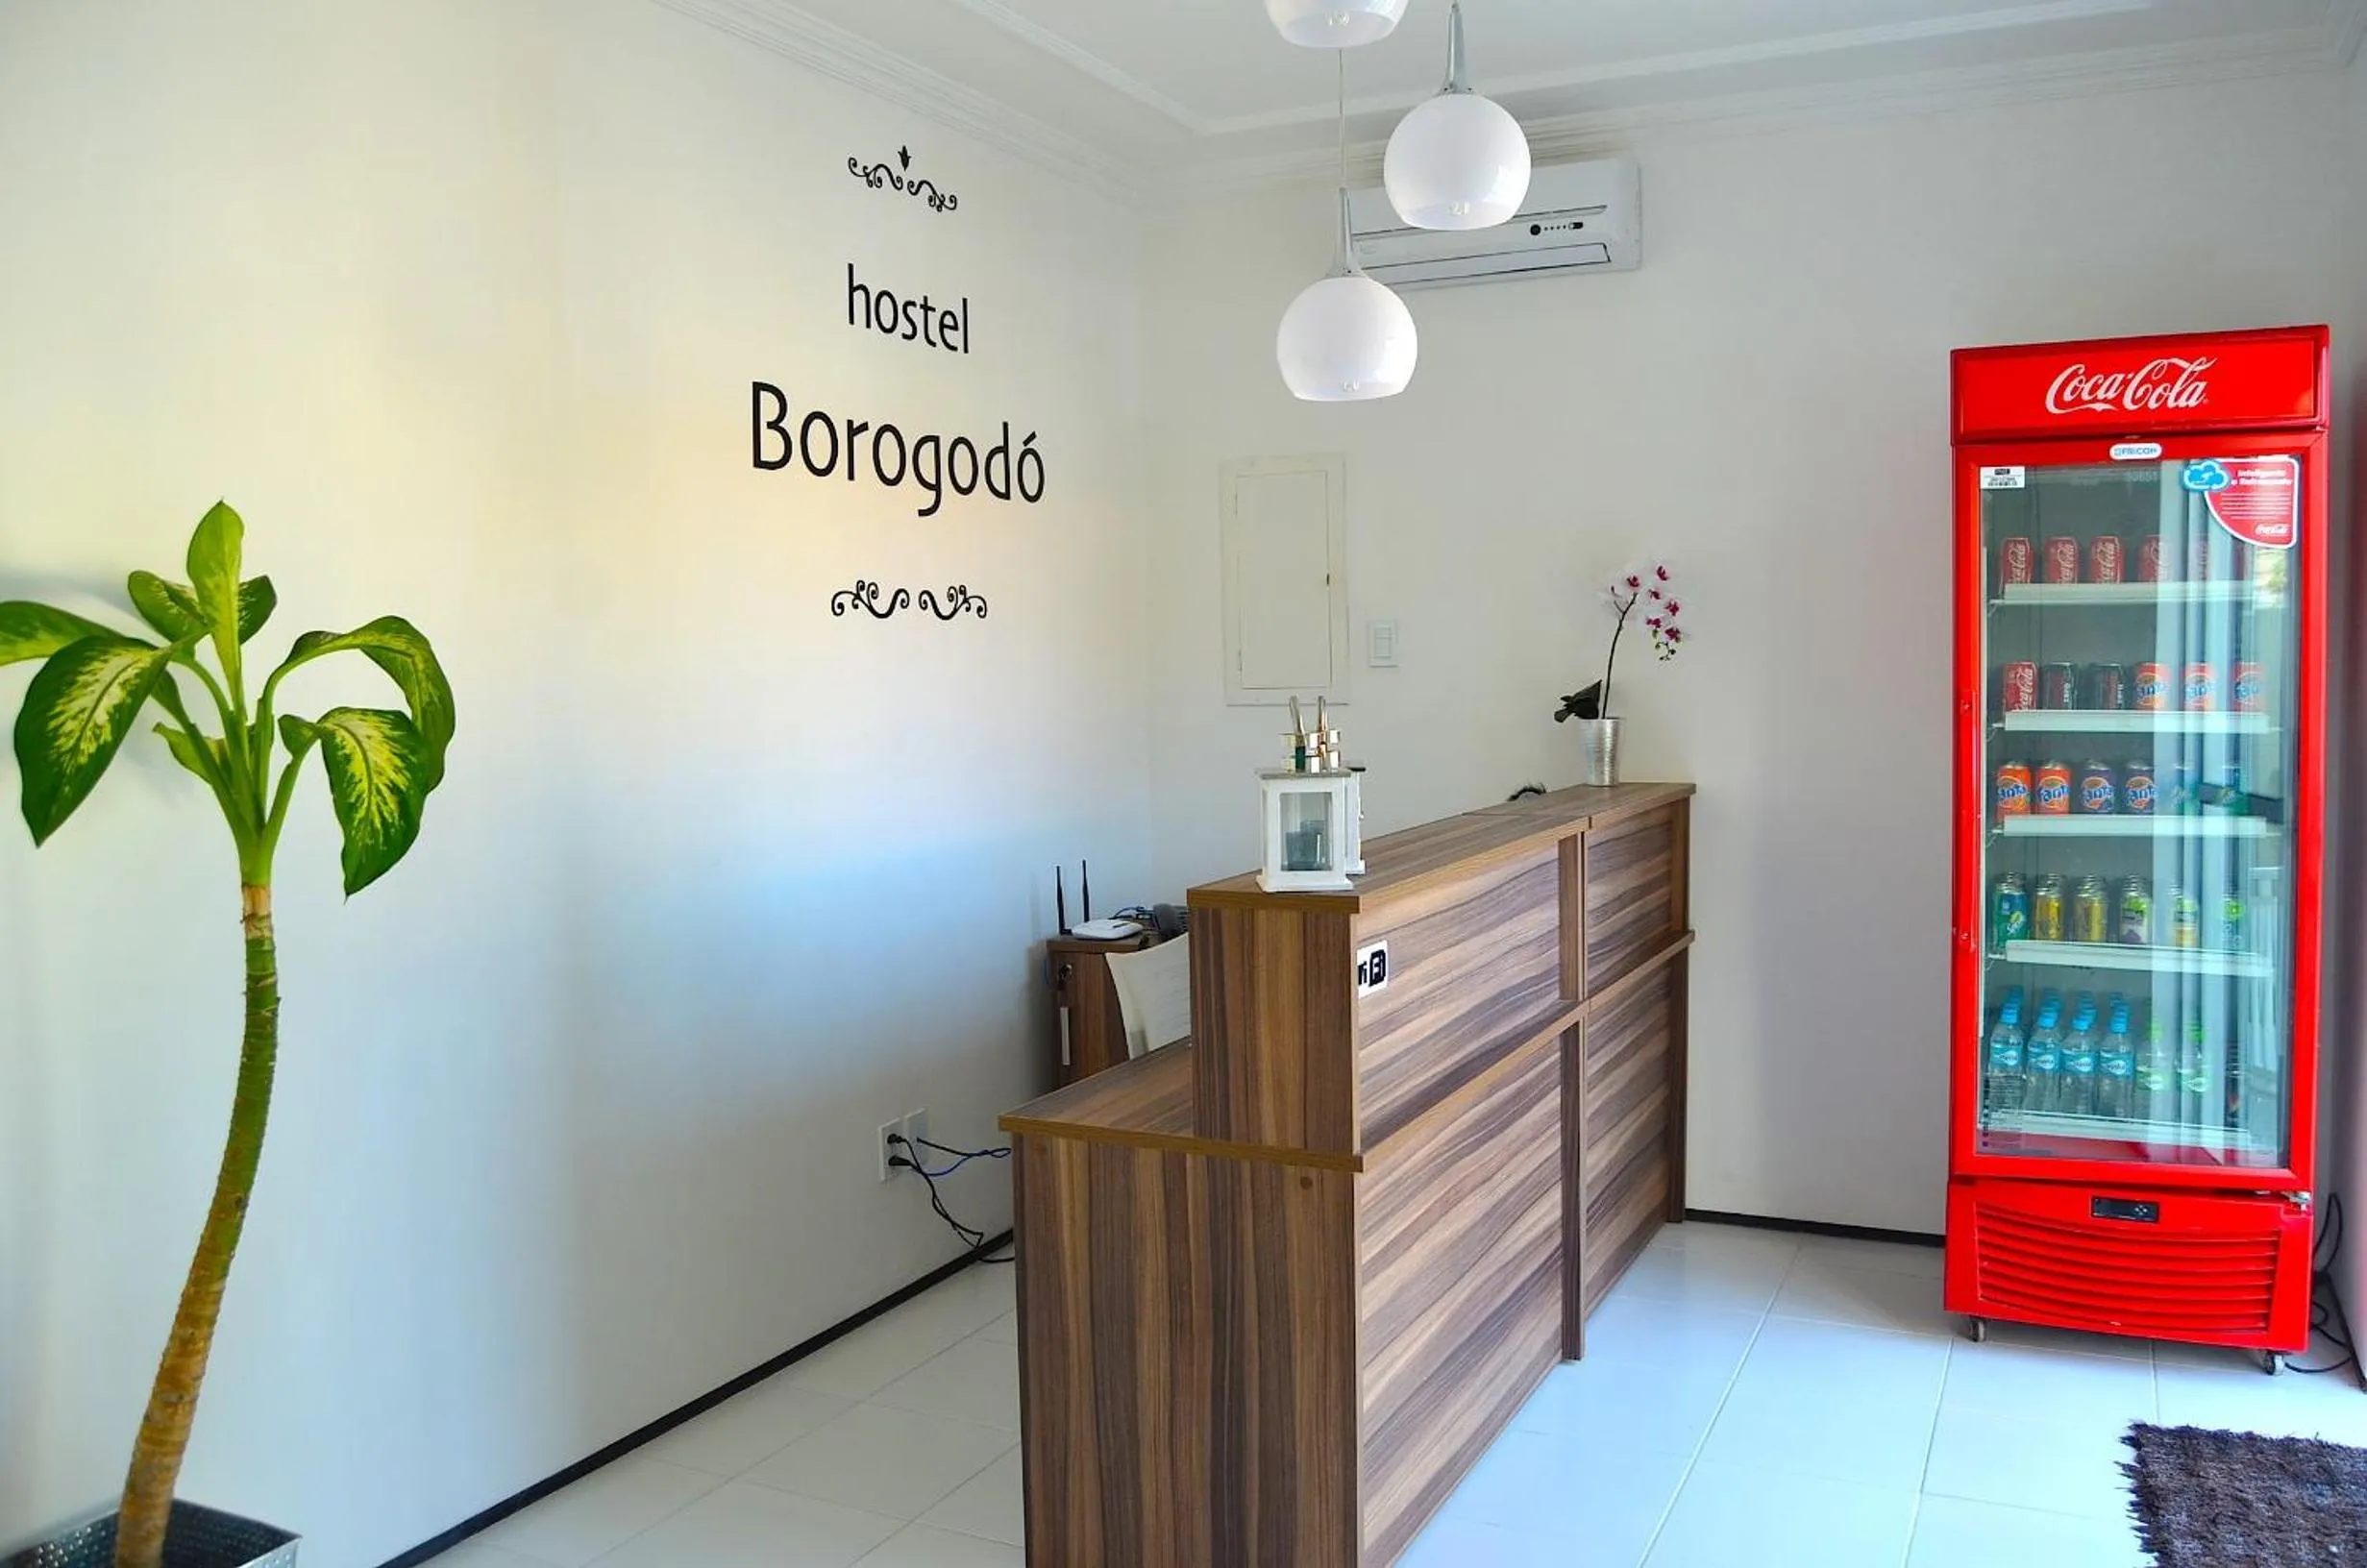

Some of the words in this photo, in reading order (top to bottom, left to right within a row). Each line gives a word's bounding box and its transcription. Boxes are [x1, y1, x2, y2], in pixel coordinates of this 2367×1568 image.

[847, 262, 969, 354] hostel
[2045, 356, 2217, 414] Coca-Cola
[752, 380, 1045, 517] Borogodó
